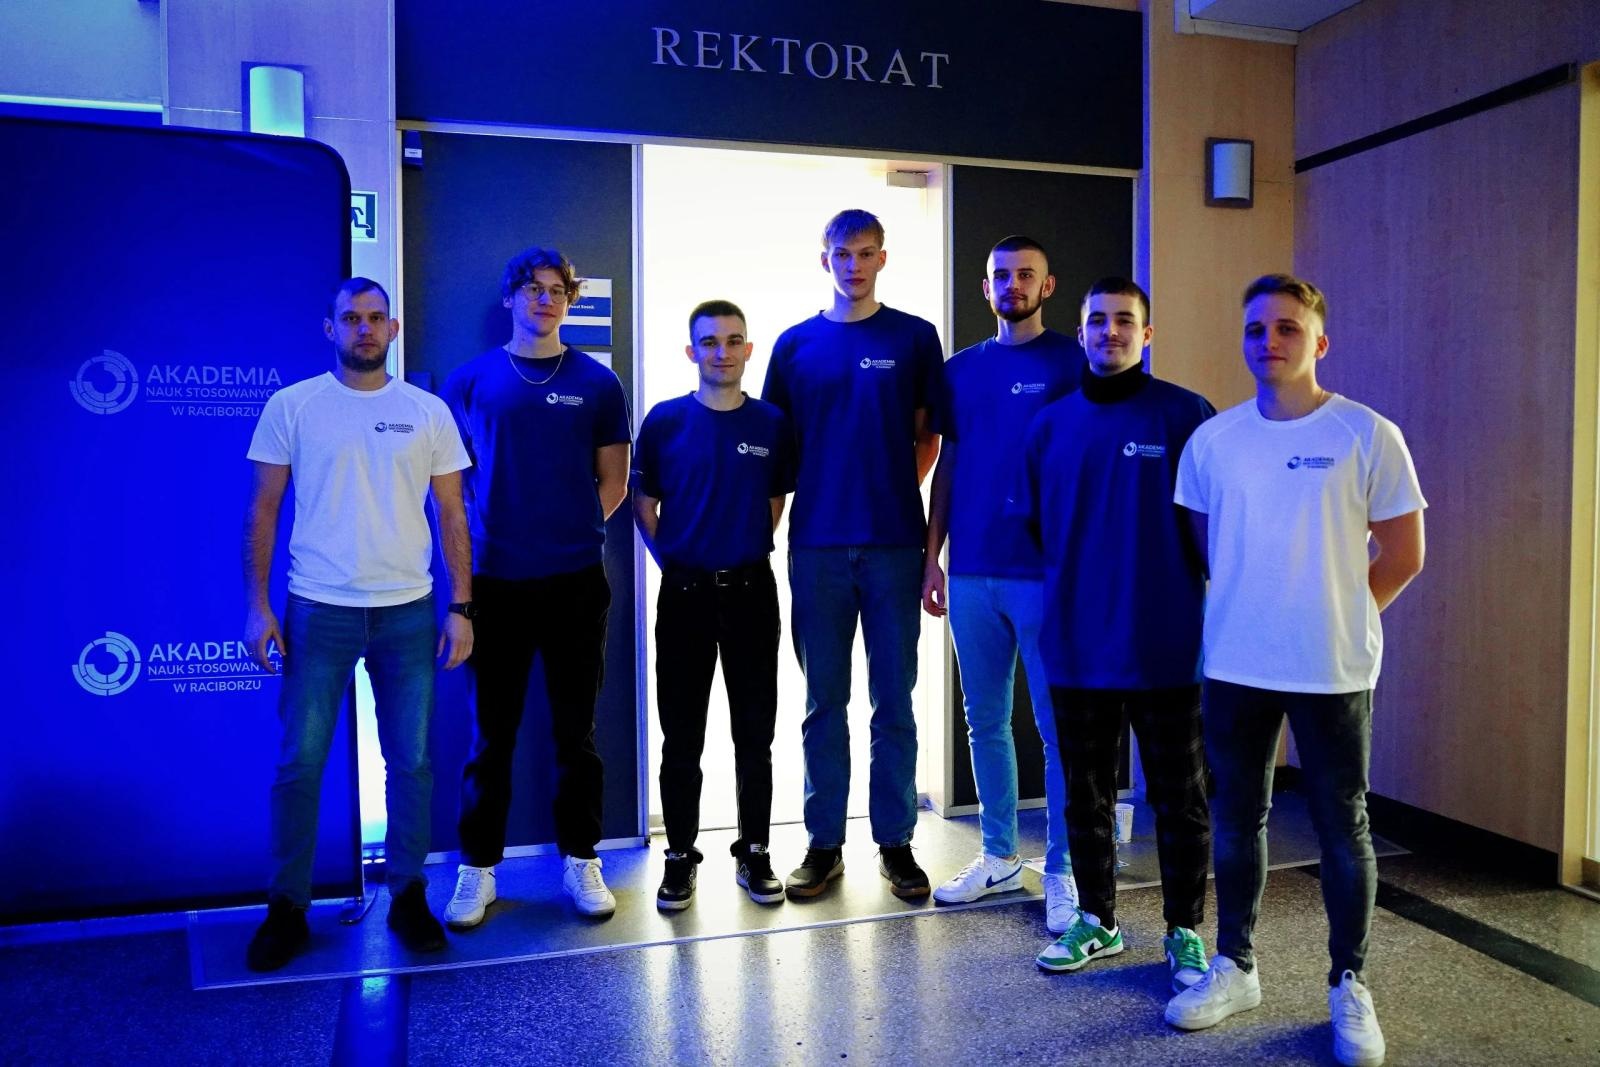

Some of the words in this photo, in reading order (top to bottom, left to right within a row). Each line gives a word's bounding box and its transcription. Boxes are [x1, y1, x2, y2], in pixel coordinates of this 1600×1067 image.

[651, 27, 949, 88] REKTORAT
[146, 364, 282, 386] AKADEMIA
[146, 387, 183, 397] NAUK
[186, 387, 278, 399] STOSOWANYC
[171, 406, 184, 416] W
[189, 406, 260, 417] RACIBORZU
[148, 664, 185, 676] NAUK
[173, 683, 185, 693] W
[190, 680, 261, 693] RACIBORZU
